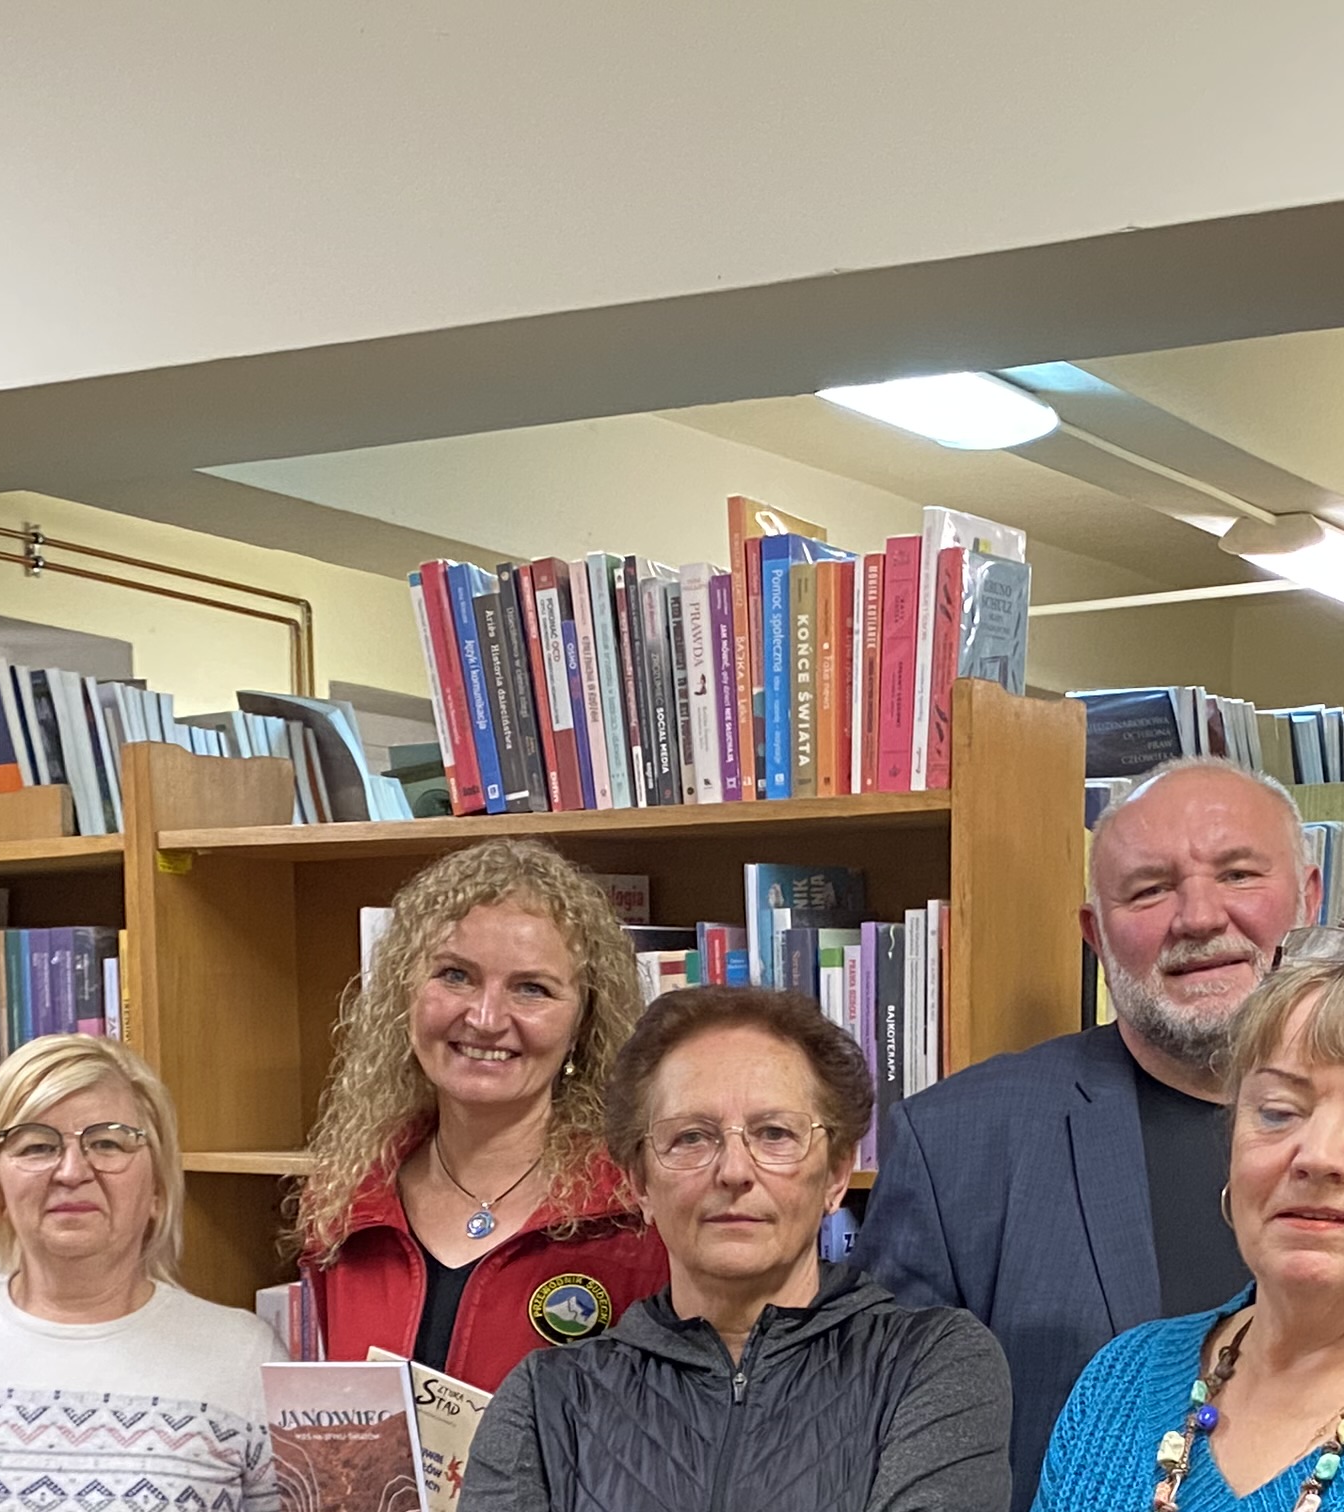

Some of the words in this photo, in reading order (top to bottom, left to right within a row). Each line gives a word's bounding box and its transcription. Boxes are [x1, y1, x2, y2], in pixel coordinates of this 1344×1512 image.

[771, 569, 783, 608] Pomoc
[867, 565, 878, 600] MONIKA
[463, 639, 477, 664] Język
[550, 640, 561, 662] OCD
[688, 601, 704, 666] PRAWDA
[769, 613, 783, 671] społeczna
[796, 614, 812, 683] KOŃCE
[489, 643, 504, 686] Historia
[566, 642, 576, 669] OSHO
[736, 636, 746, 679] BAJKA
[468, 669, 488, 730] komunikacja
[720, 671, 728, 684] gdy
[724, 707, 732, 720] NIE
[822, 682, 830, 709] news
[496, 688, 514, 749] dzieciństwa
[655, 707, 666, 742] SOCIAL
[797, 691, 812, 766] ŚWIATA
[659, 743, 669, 773] MEDIA
[1147, 740, 1173, 750] PRAW
[610, 884, 645, 910] logia
[847, 959, 857, 986] PRAWA
[886, 1005, 895, 1081] BAJKOTERAPIA
[532, 1276, 583, 1318] PRZEWODNIK
[586, 1280, 608, 1325] SUDECKI
[278, 1408, 392, 1428] JANOWIEC
